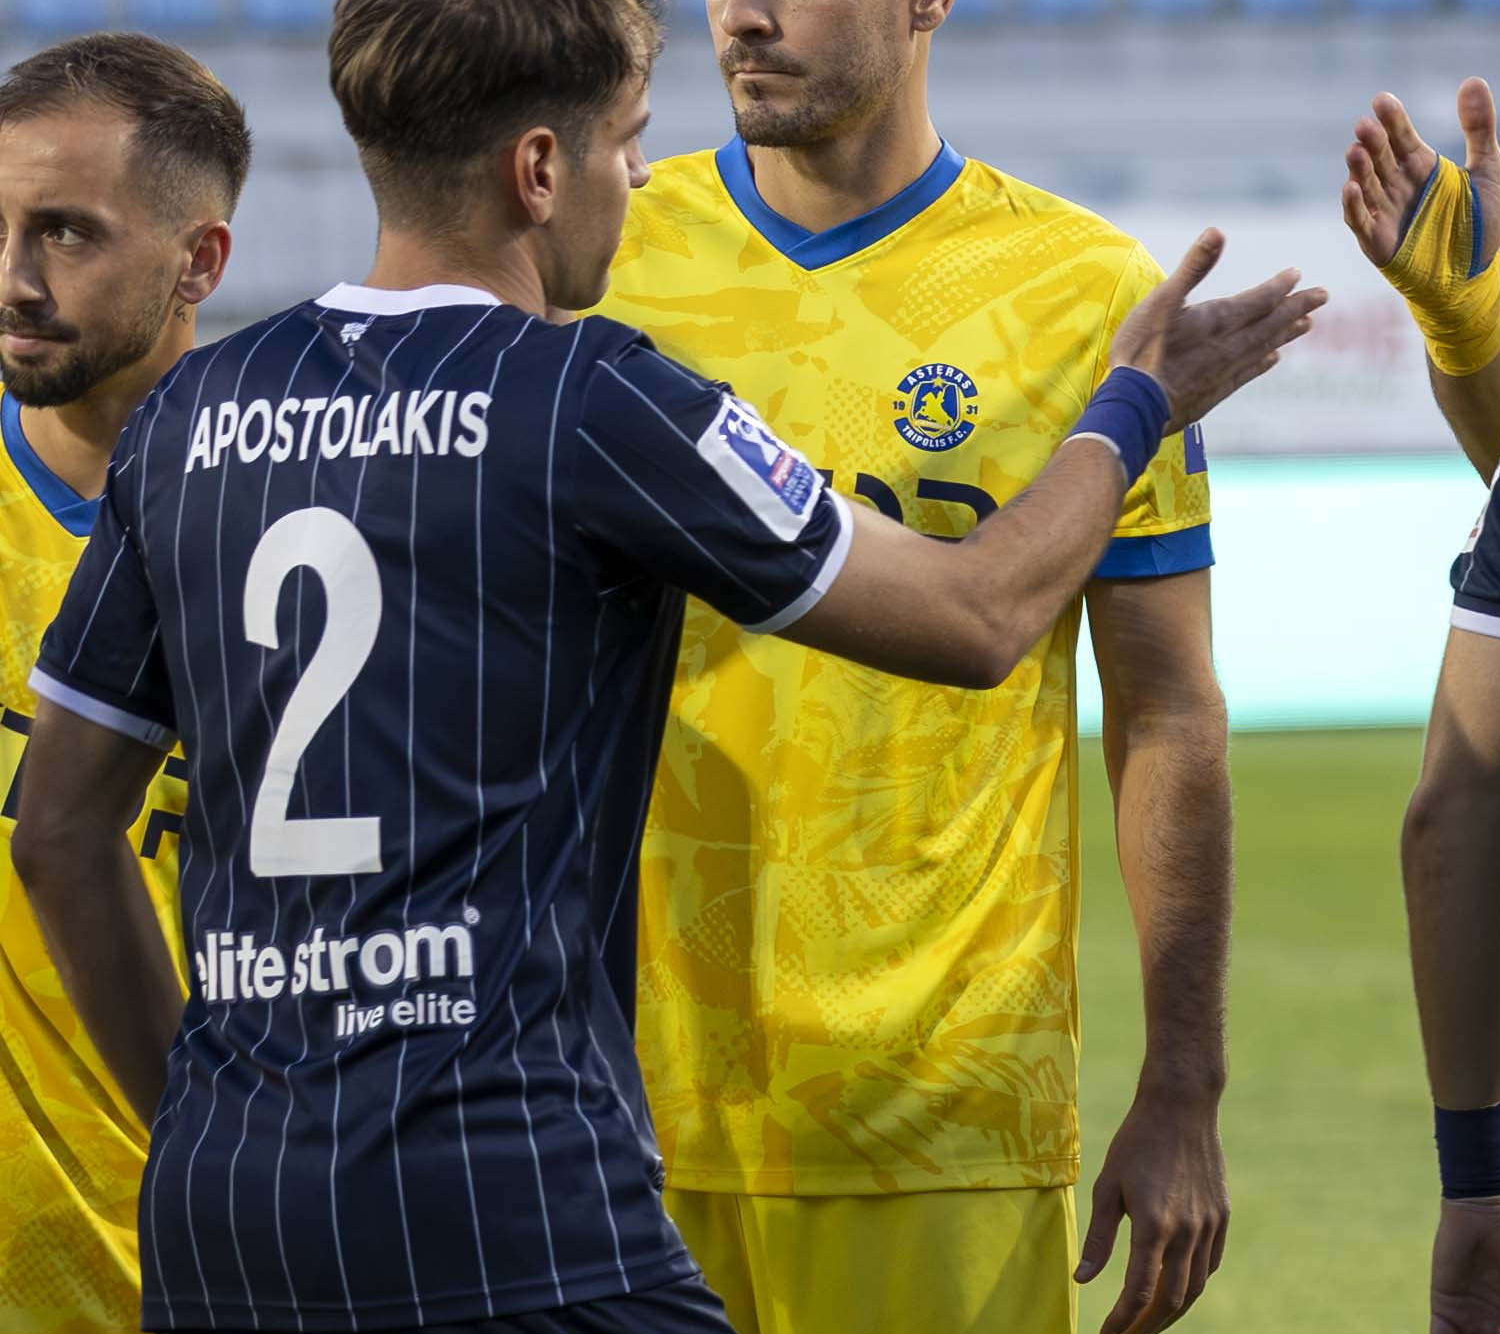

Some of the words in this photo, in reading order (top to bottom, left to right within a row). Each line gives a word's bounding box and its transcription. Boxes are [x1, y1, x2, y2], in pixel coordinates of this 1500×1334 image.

[906, 365, 972, 389] ASTERAS
[185, 391, 492, 473] APOSTOLAKIS
[902, 425, 946, 447] TRIPOLIS
[243, 506, 383, 878] 2
[290, 923, 474, 996] strom
[336, 1004, 384, 1037] live
[391, 993, 477, 1026] elite
